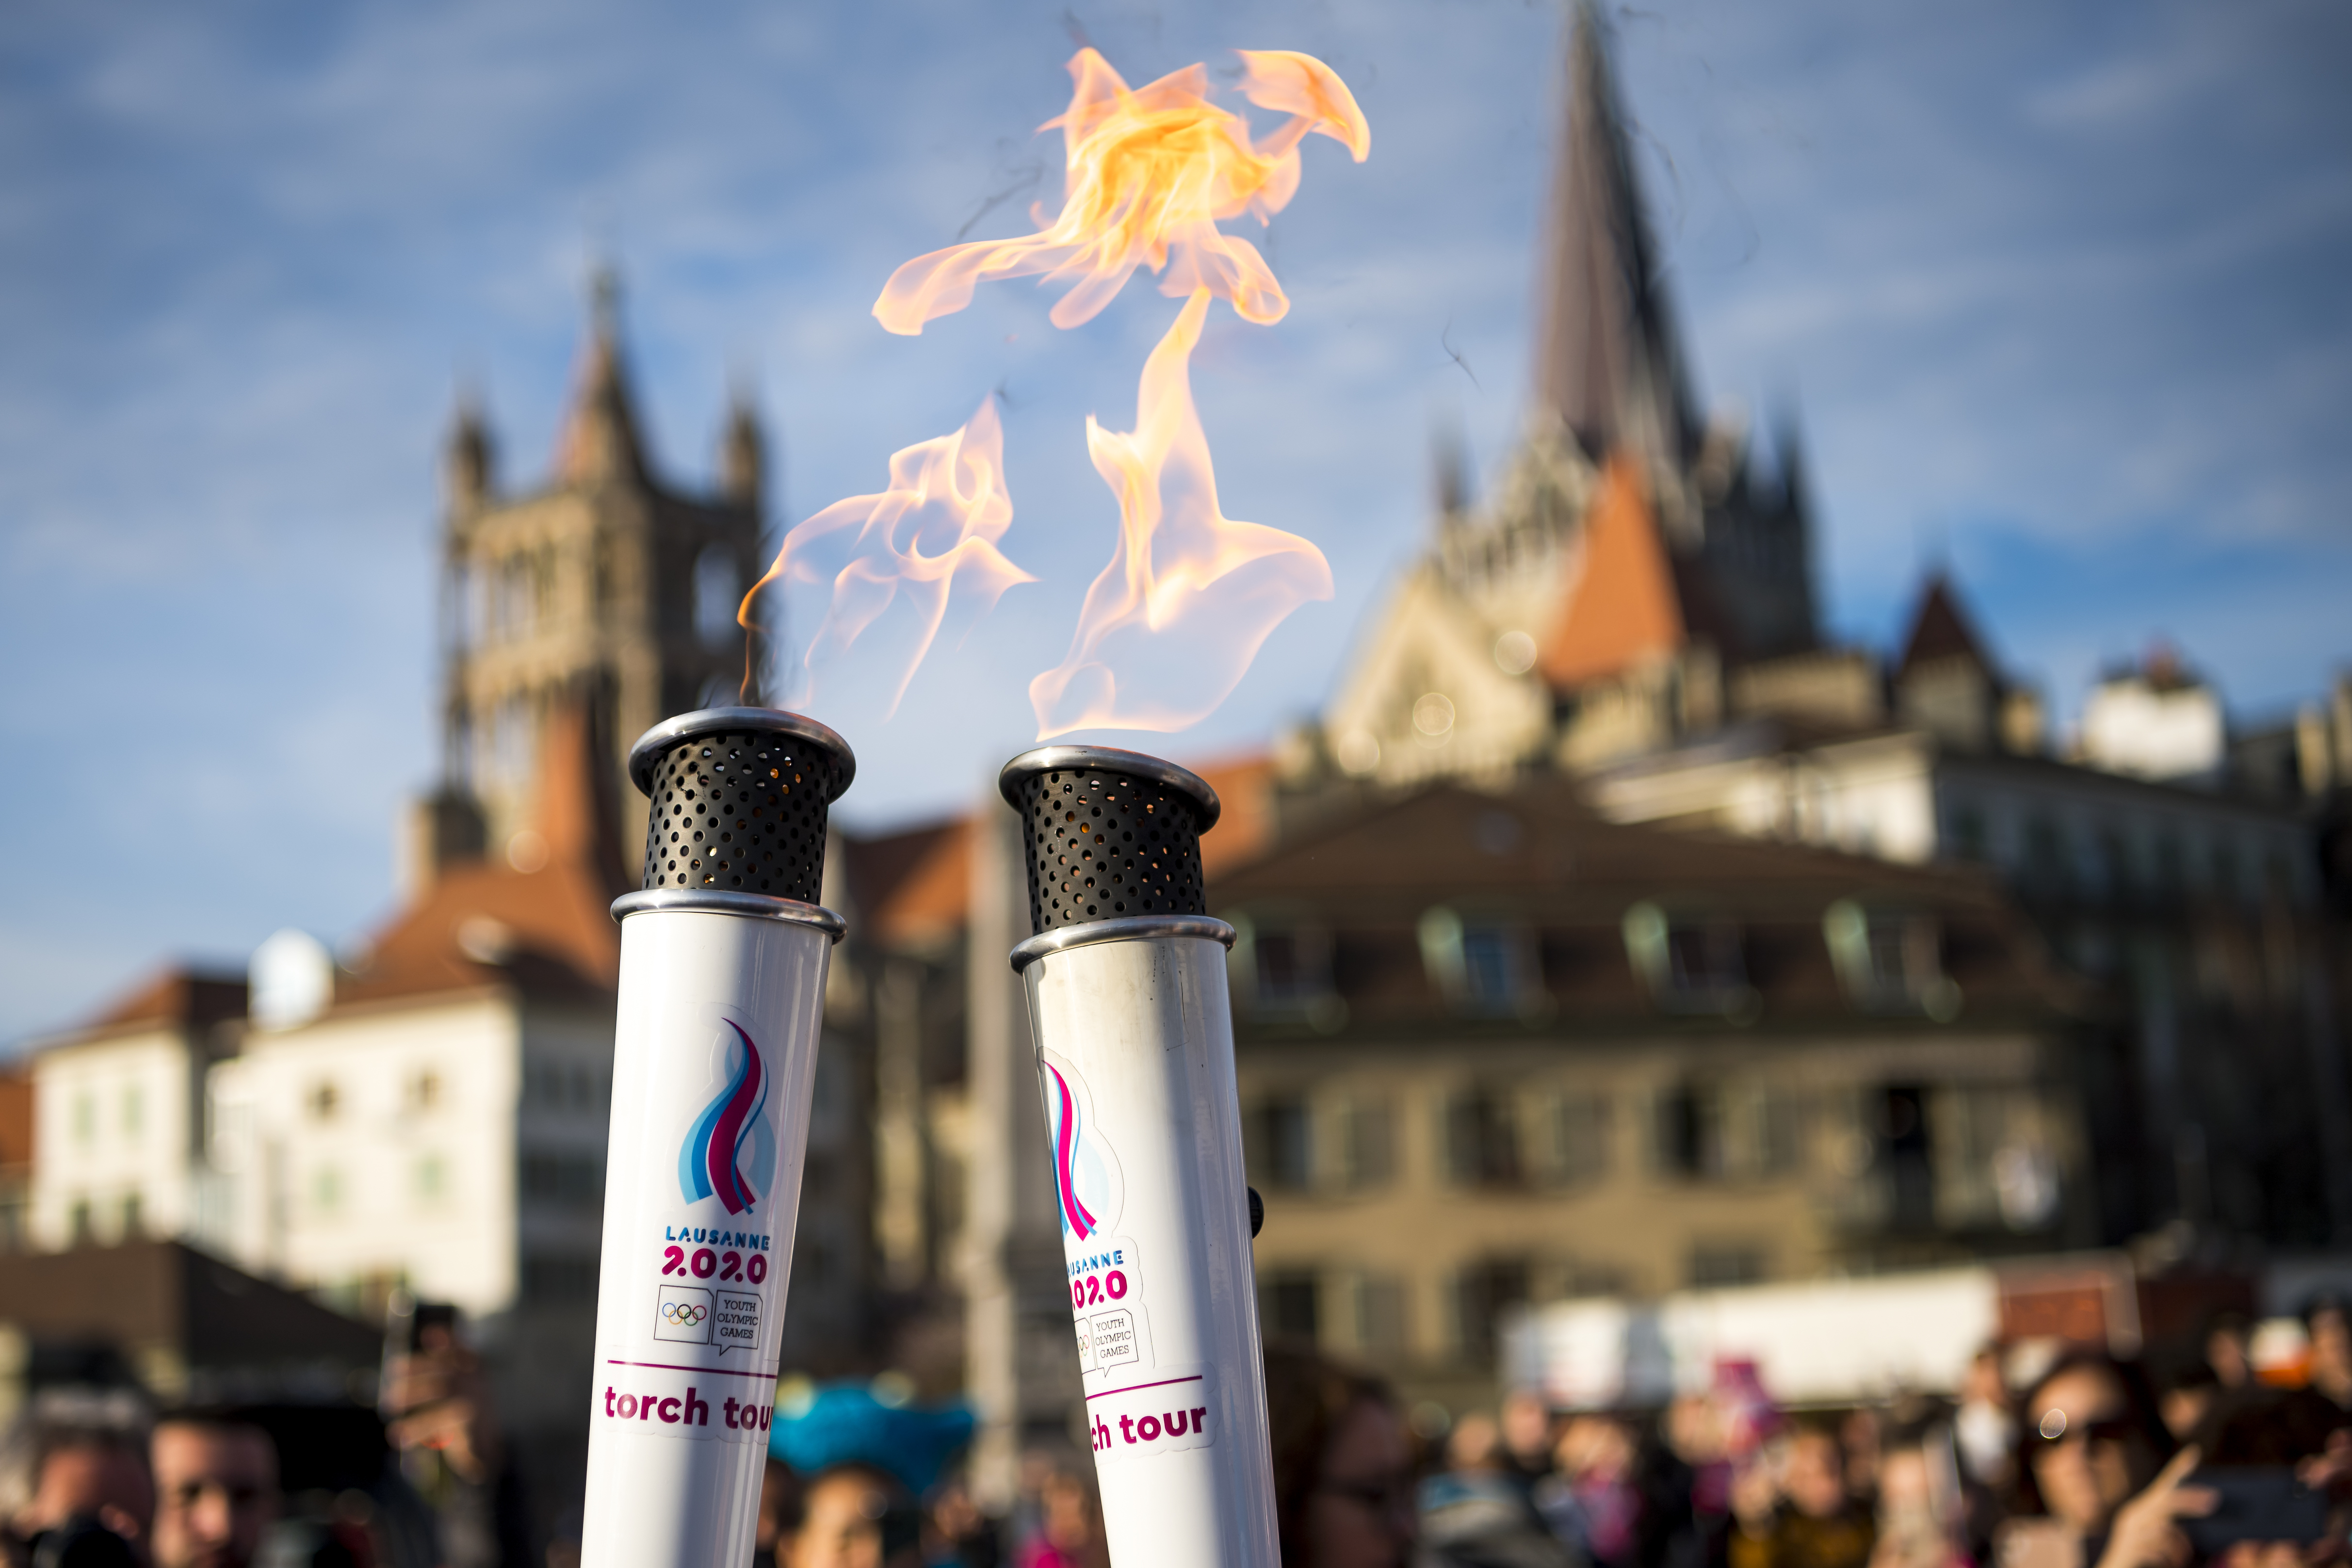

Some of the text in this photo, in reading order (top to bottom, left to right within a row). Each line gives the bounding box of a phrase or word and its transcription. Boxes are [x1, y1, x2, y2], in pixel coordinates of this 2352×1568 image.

[665, 1226, 770, 1251] LAUSANNE
[1067, 1250, 1124, 1278] AUSANNE
[1069, 1270, 1127, 1311] 020
[724, 1299, 756, 1312] YOUTH
[717, 1313, 758, 1326] OLYMPIC
[1096, 1318, 1124, 1331] YOUTH
[720, 1327, 753, 1339] GAMES
[1095, 1331, 1131, 1345] OLYMPIC
[1100, 1345, 1129, 1358] GAMES
[605, 1387, 709, 1426] torch
[1119, 1407, 1207, 1444] tour
